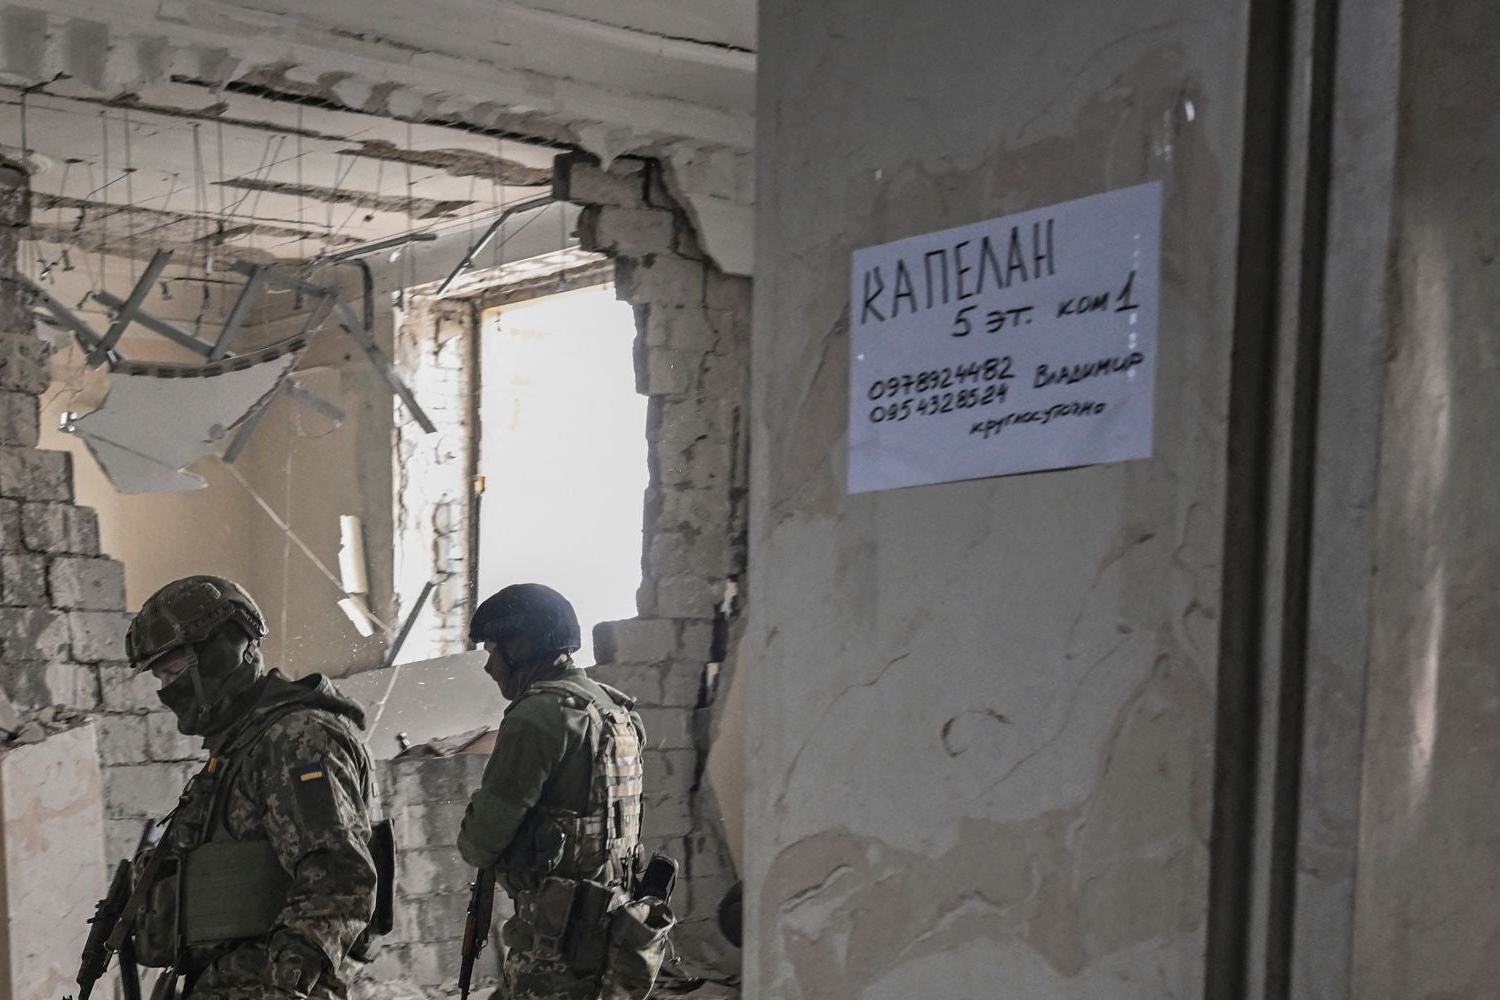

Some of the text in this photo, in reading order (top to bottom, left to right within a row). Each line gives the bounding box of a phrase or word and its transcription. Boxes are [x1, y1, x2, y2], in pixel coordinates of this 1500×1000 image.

[860, 218, 1056, 325] КАПЕЛАН
[950, 304, 978, 338] 5
[1115, 270, 1140, 313] 1
[868, 356, 1016, 400] 0978924482
